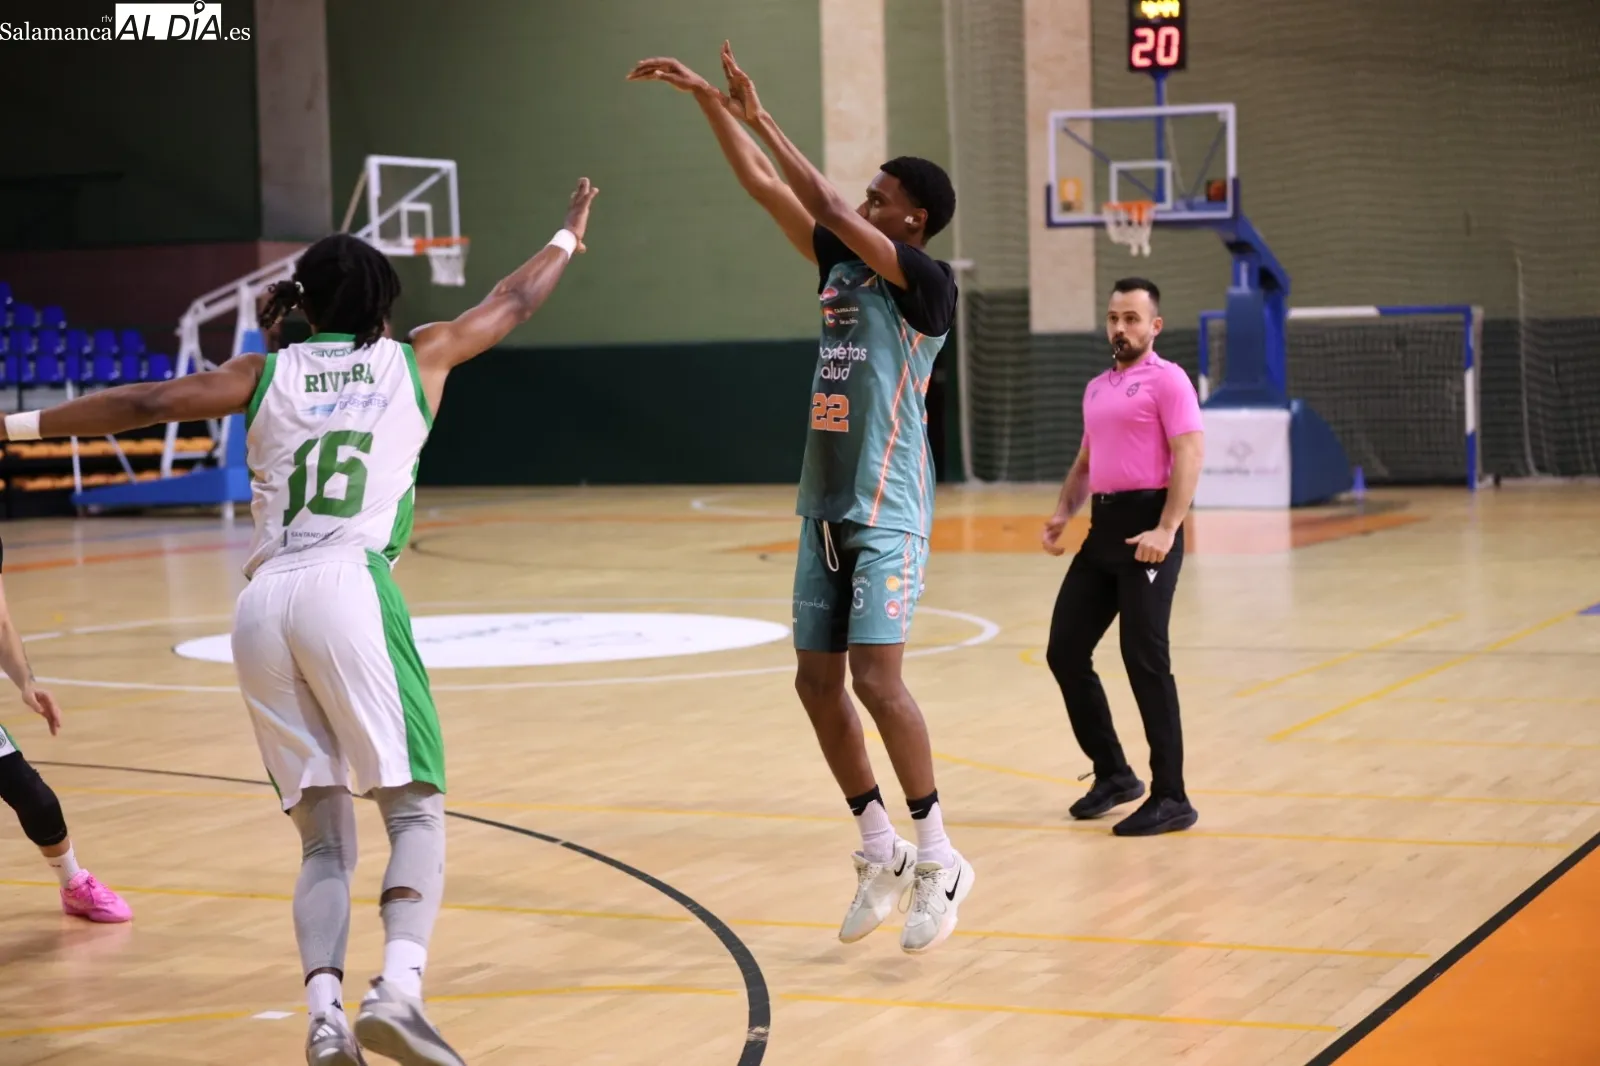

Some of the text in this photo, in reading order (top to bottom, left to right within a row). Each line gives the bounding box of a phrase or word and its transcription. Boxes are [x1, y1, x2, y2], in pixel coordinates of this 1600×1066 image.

[1131, 25, 1180, 68] 20
[304, 362, 375, 393] RIVERA
[811, 392, 849, 432] 22
[282, 430, 374, 526] 16
